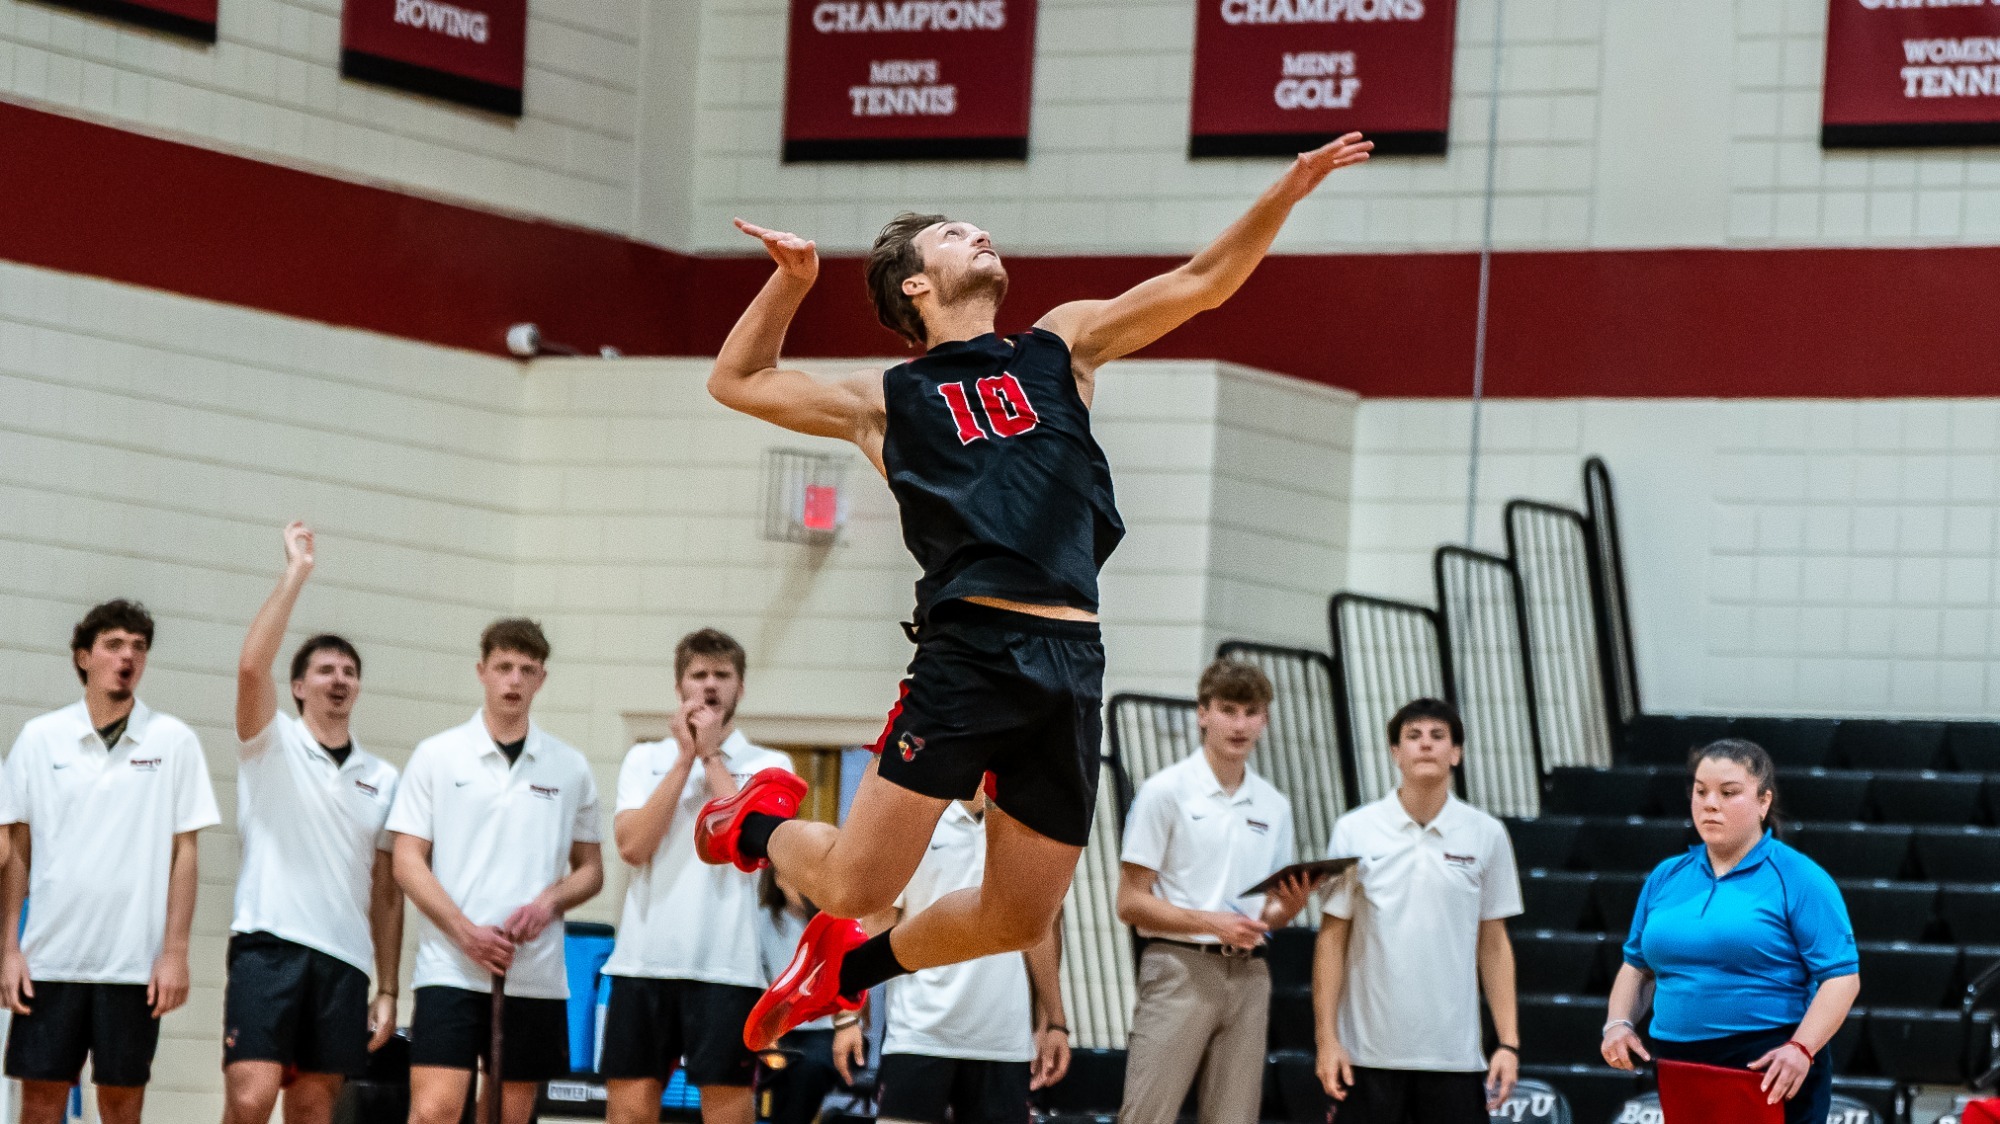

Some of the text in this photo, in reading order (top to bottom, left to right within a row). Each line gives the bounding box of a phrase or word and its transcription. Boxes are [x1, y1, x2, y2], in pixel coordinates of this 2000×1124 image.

[394, 0, 488, 43] ROWING
[812, 0, 1006, 33] CHAMPIONS
[1220, 0, 1426, 24] CHAMPIONS
[869, 59, 939, 83] MEN'S
[1282, 52, 1356, 76] MEN'S
[849, 84, 957, 116] TENNIS
[1273, 78, 1362, 109] GOLF
[937, 370, 1040, 446] 10
